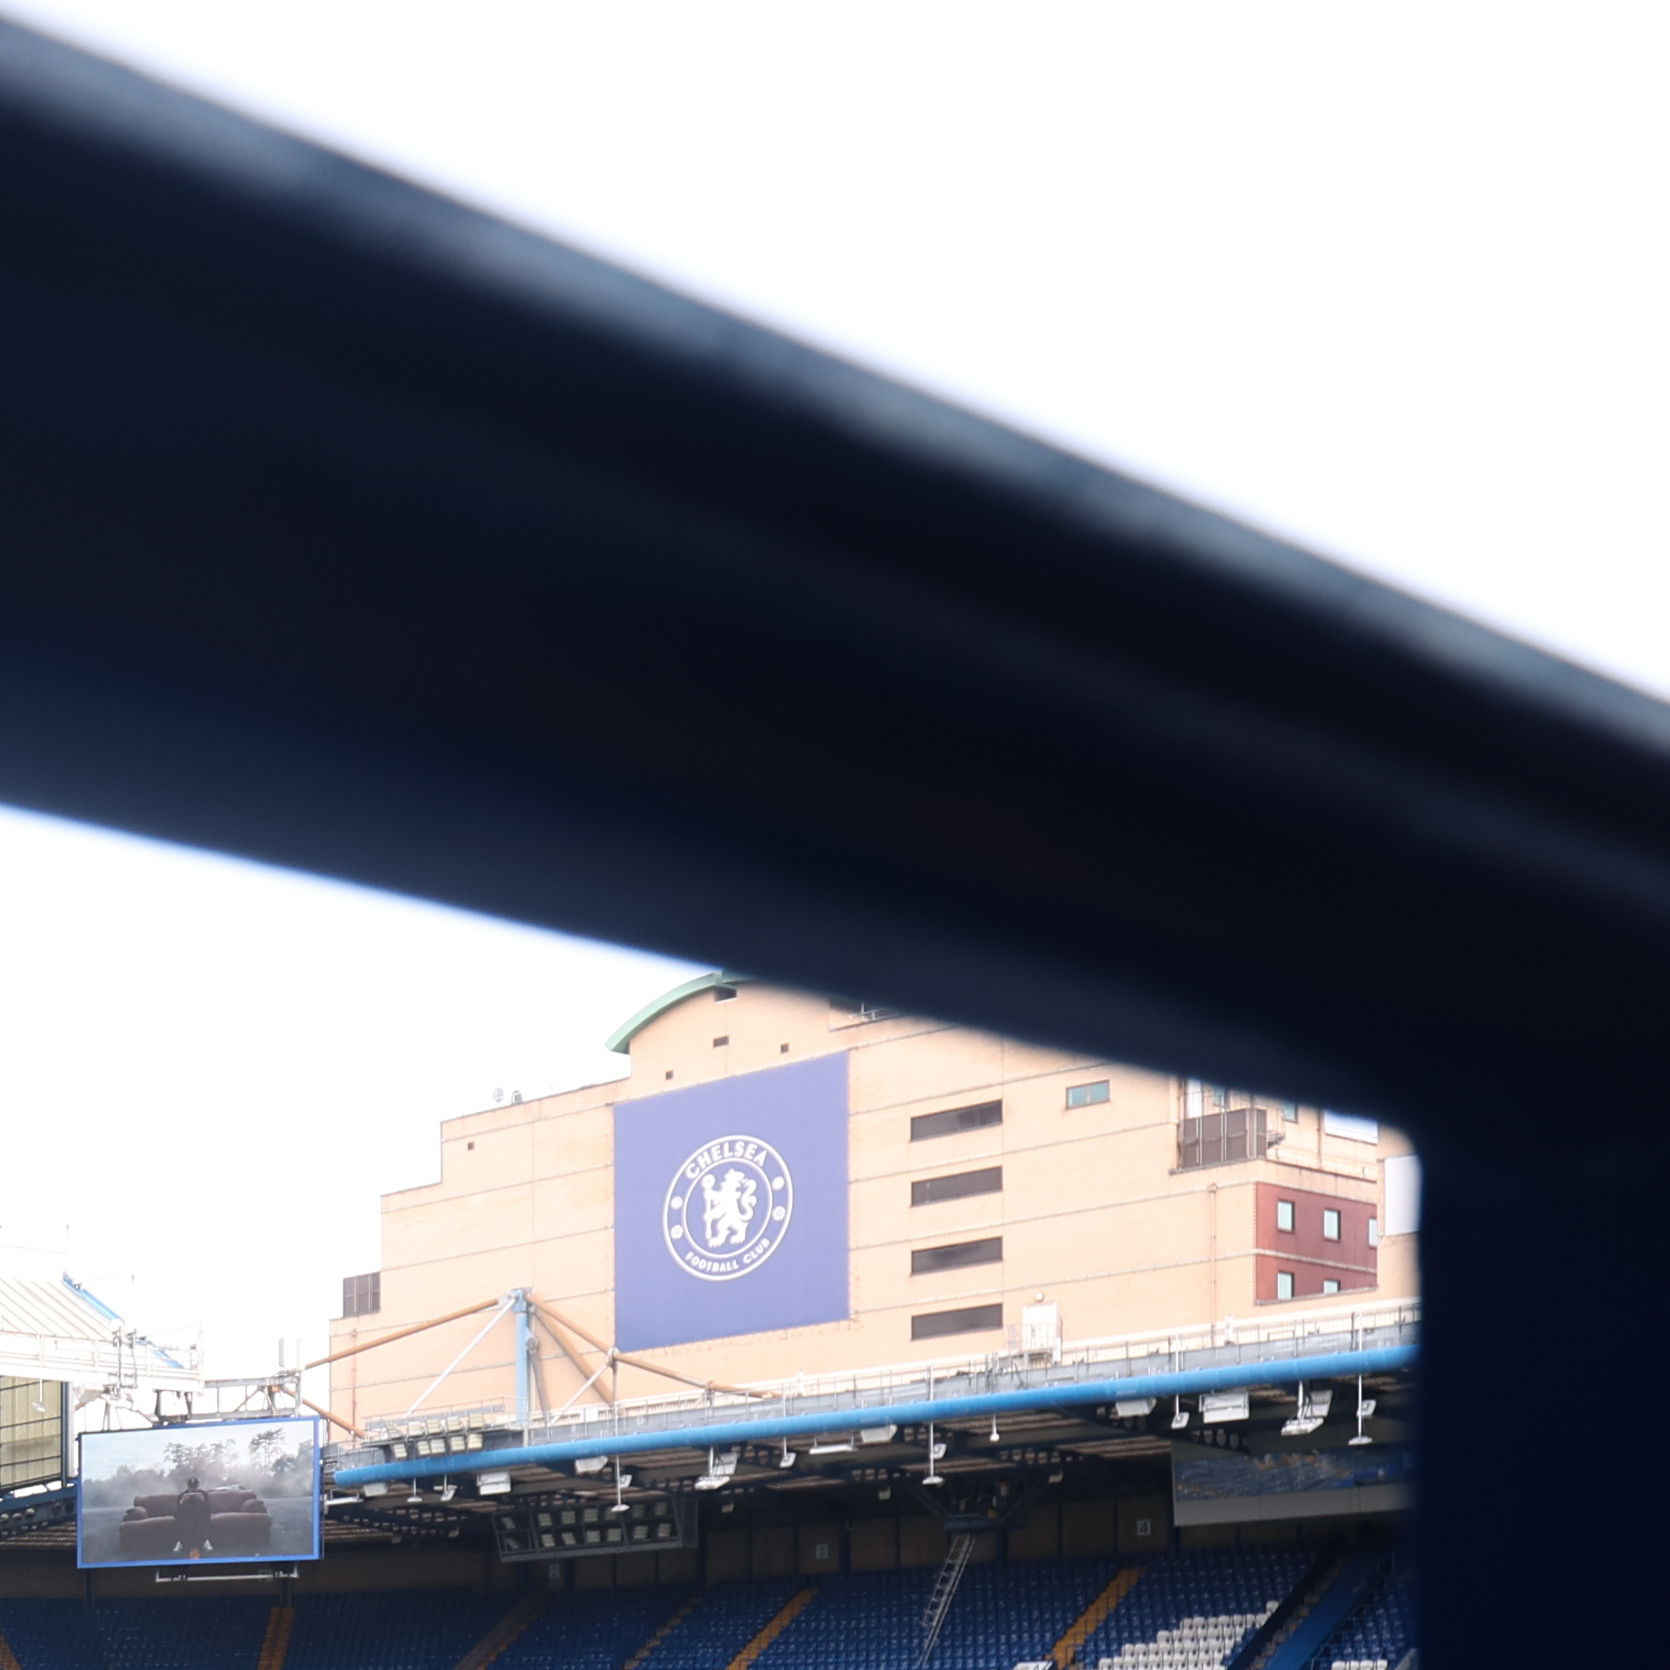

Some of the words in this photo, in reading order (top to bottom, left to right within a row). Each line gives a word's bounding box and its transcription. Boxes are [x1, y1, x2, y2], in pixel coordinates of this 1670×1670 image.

[686, 1141, 767, 1179] CHELSEA
[685, 1251, 739, 1272] FOOTBALL
[743, 1238, 770, 1264] CLUB
